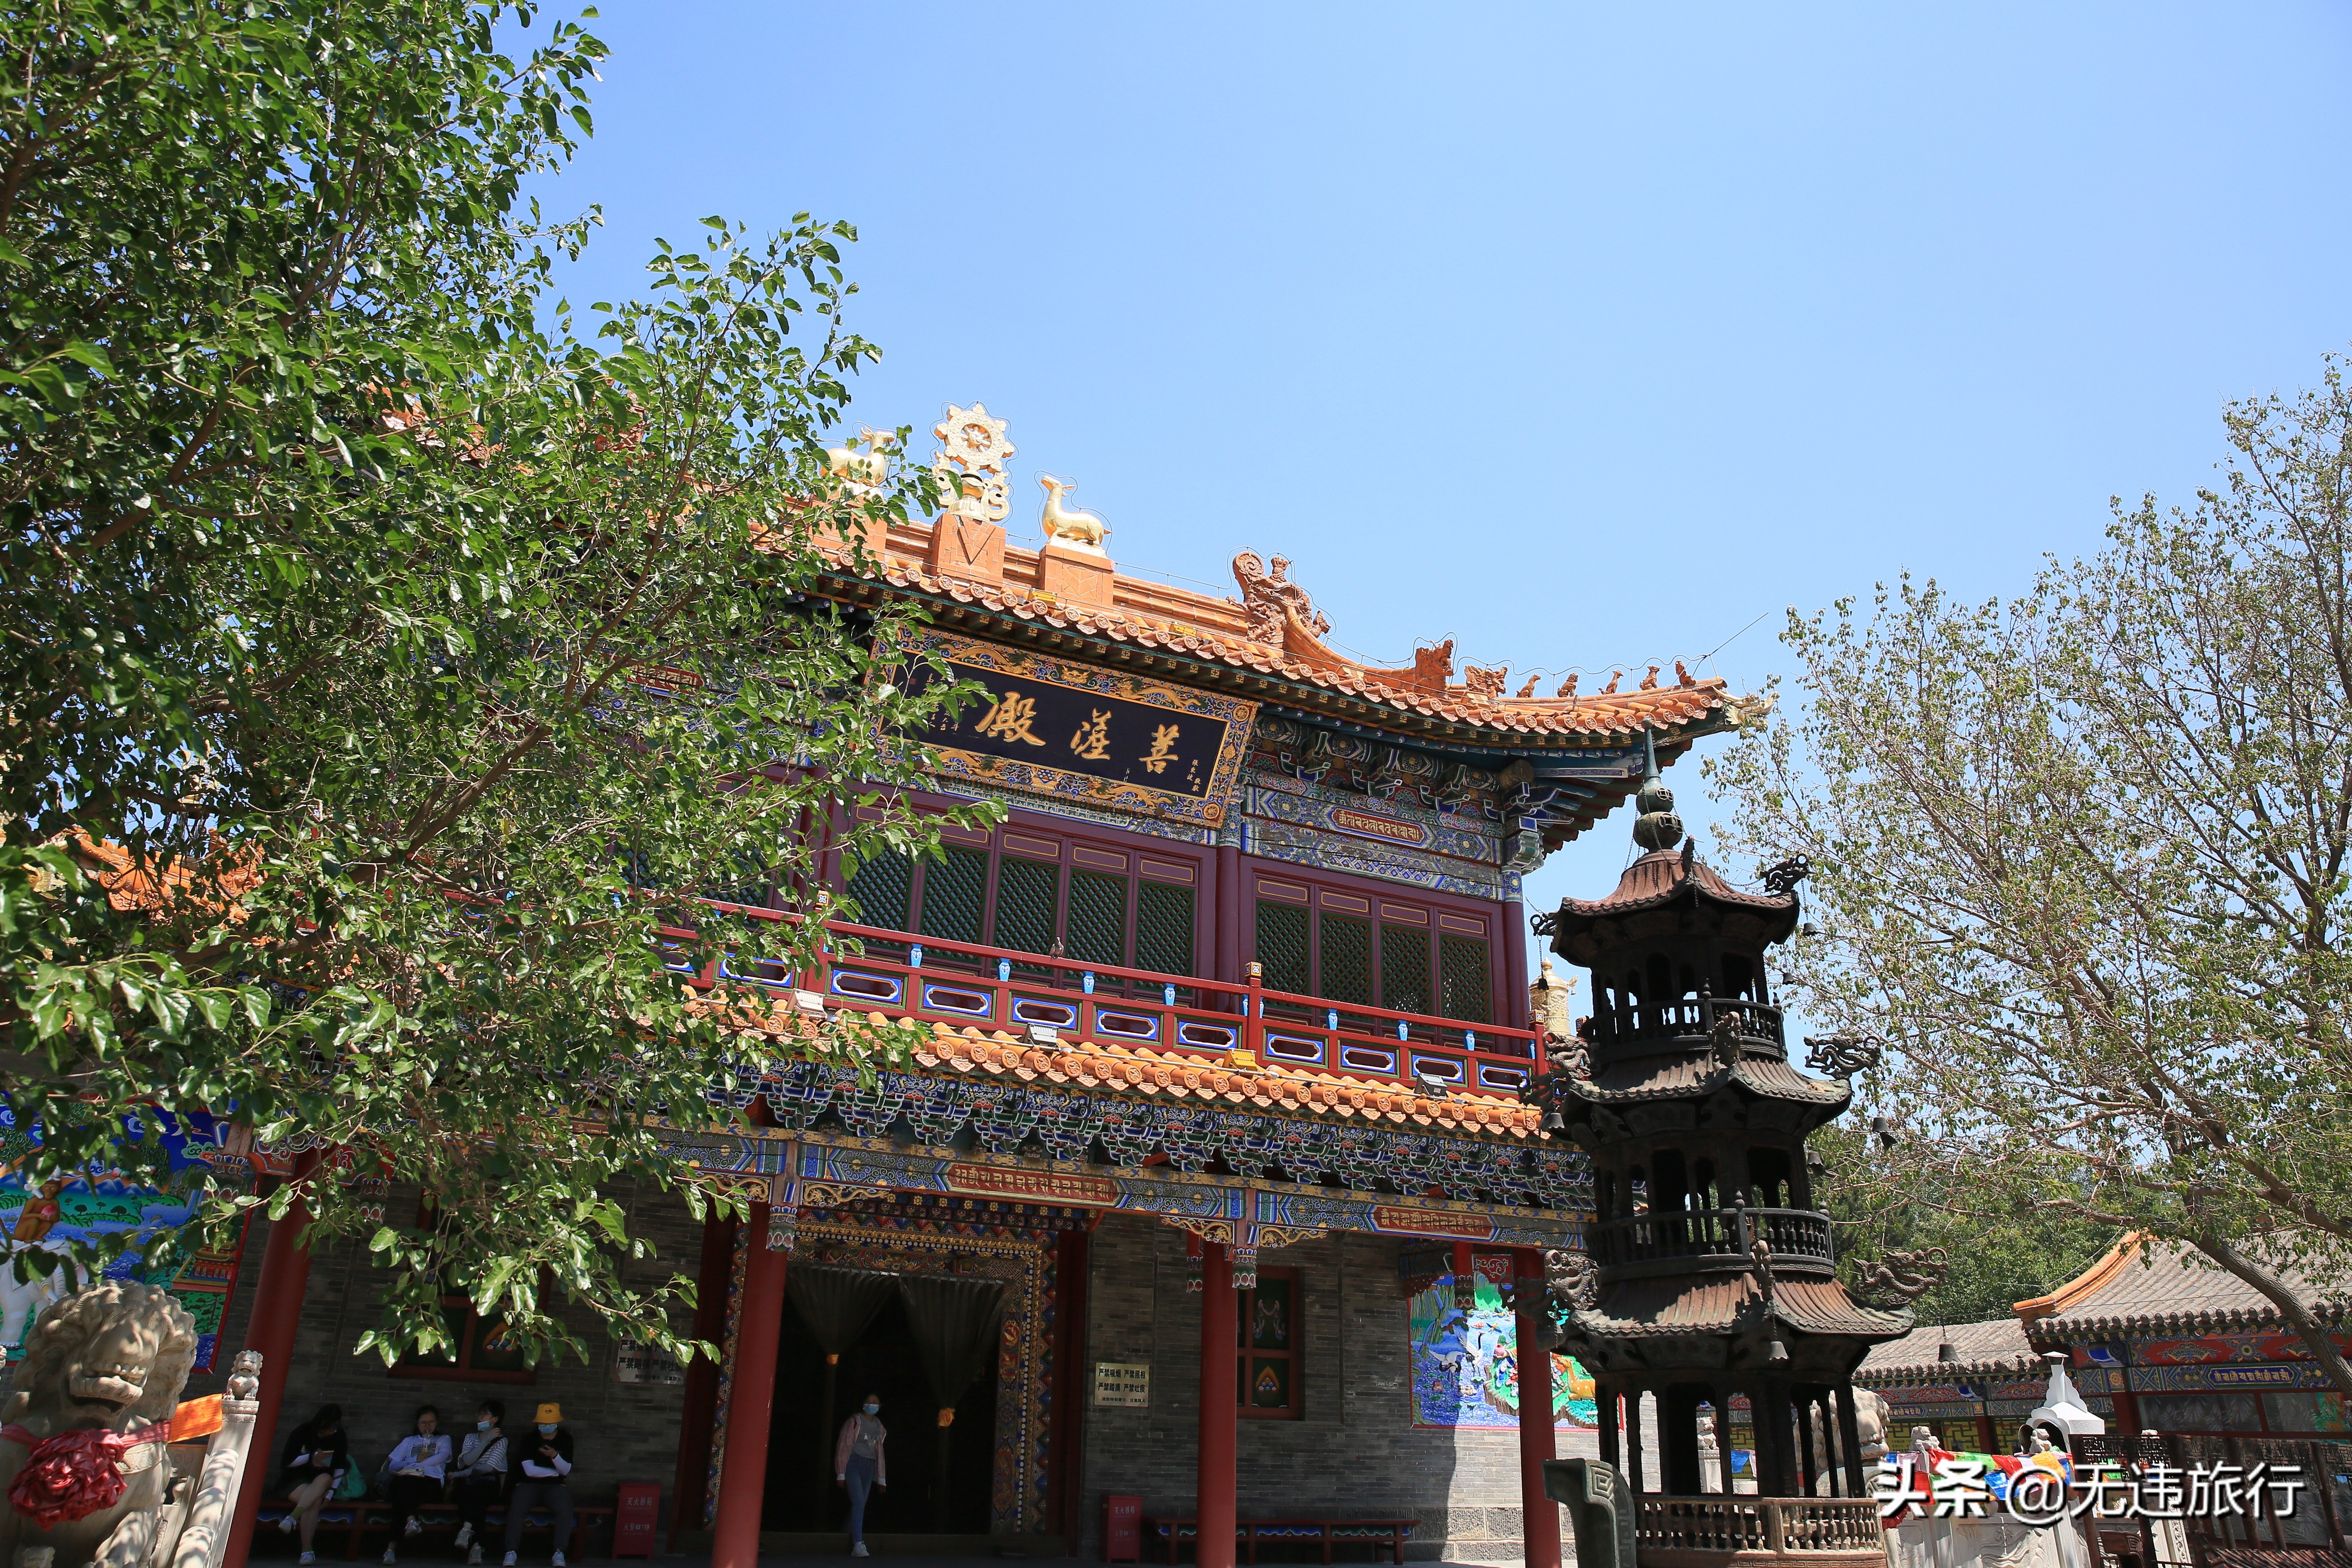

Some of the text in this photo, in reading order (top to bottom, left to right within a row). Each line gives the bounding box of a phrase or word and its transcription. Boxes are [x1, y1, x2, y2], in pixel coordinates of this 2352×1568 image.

[1098, 1368, 1146, 1379] 严禁吸烟 严禁照相
[1123, 1383, 1145, 1393] 严禁吐痰
[628, 1497, 653, 1506] 灭火器箱
[1115, 1506, 1135, 1514] 灭火器箱
